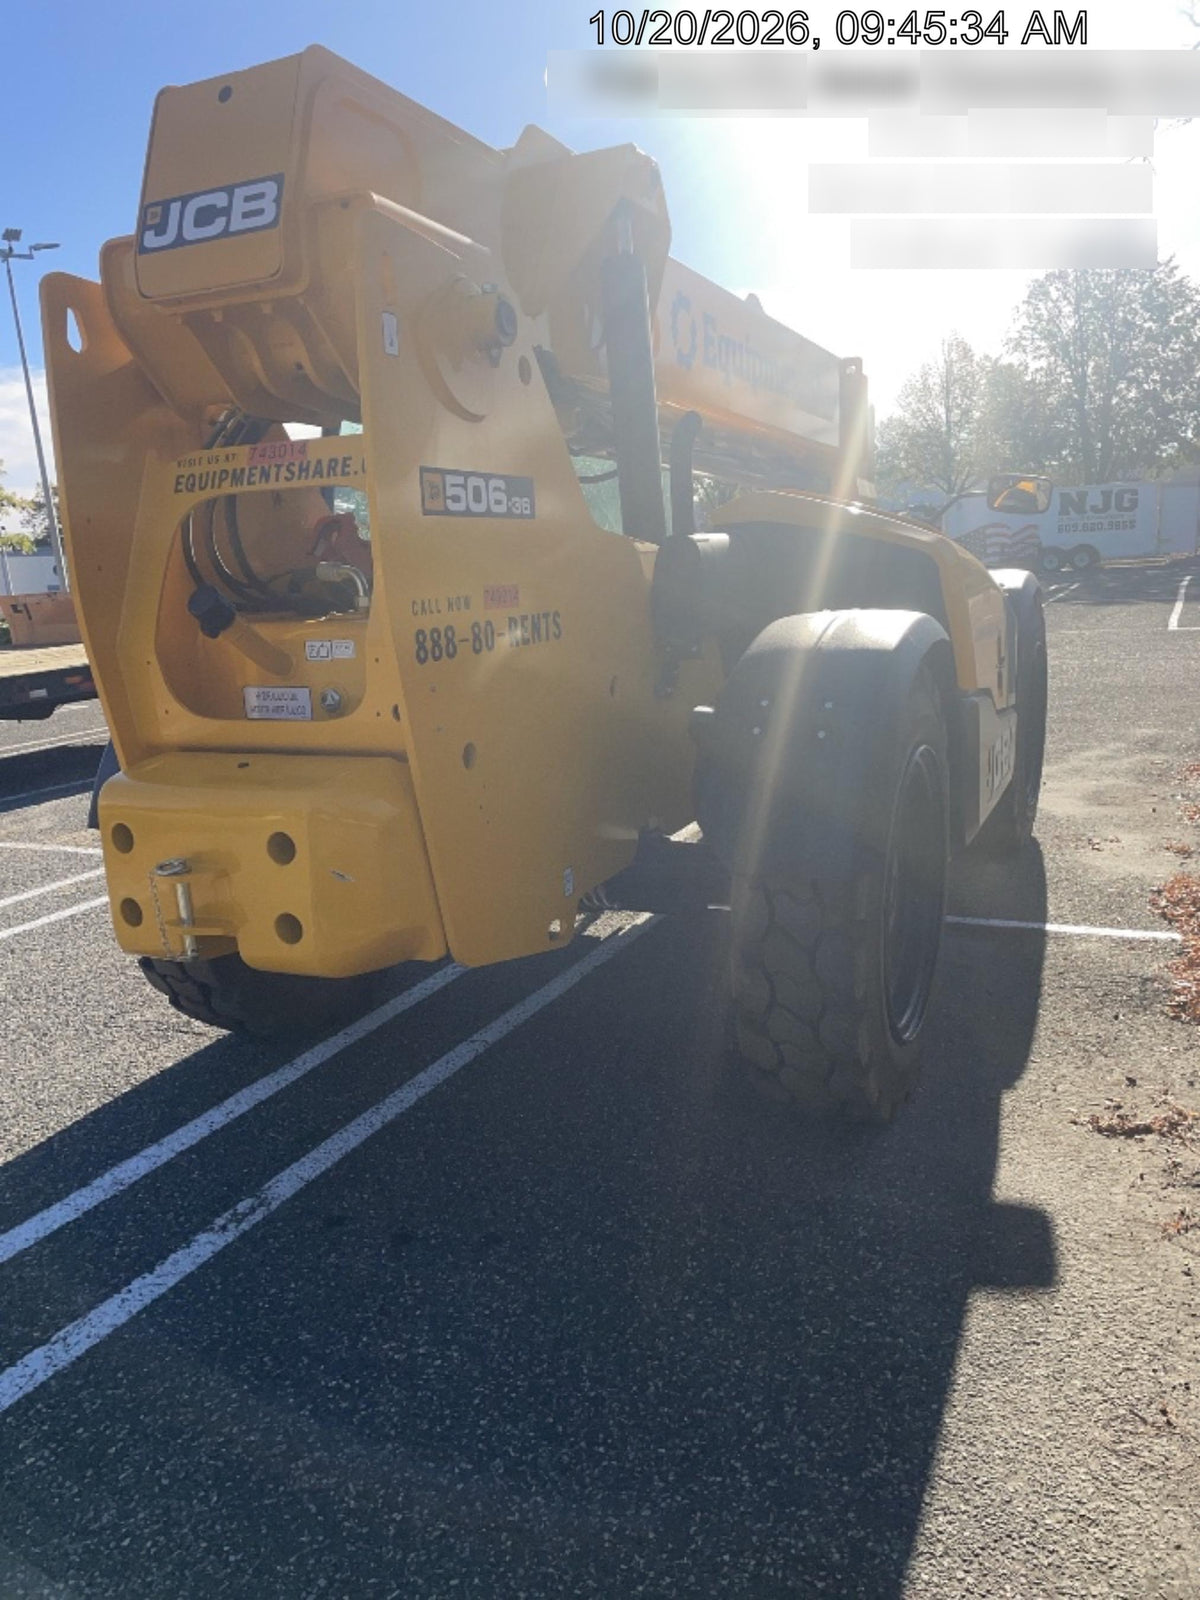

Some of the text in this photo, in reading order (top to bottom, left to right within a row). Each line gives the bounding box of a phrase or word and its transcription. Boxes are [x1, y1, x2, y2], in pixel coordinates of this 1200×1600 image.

[143, 181, 278, 248] JCB
[174, 456, 366, 494] EQUIPMENTSHARE.
[1058, 488, 1139, 516] NJG
[411, 595, 472, 616] CALL NOW
